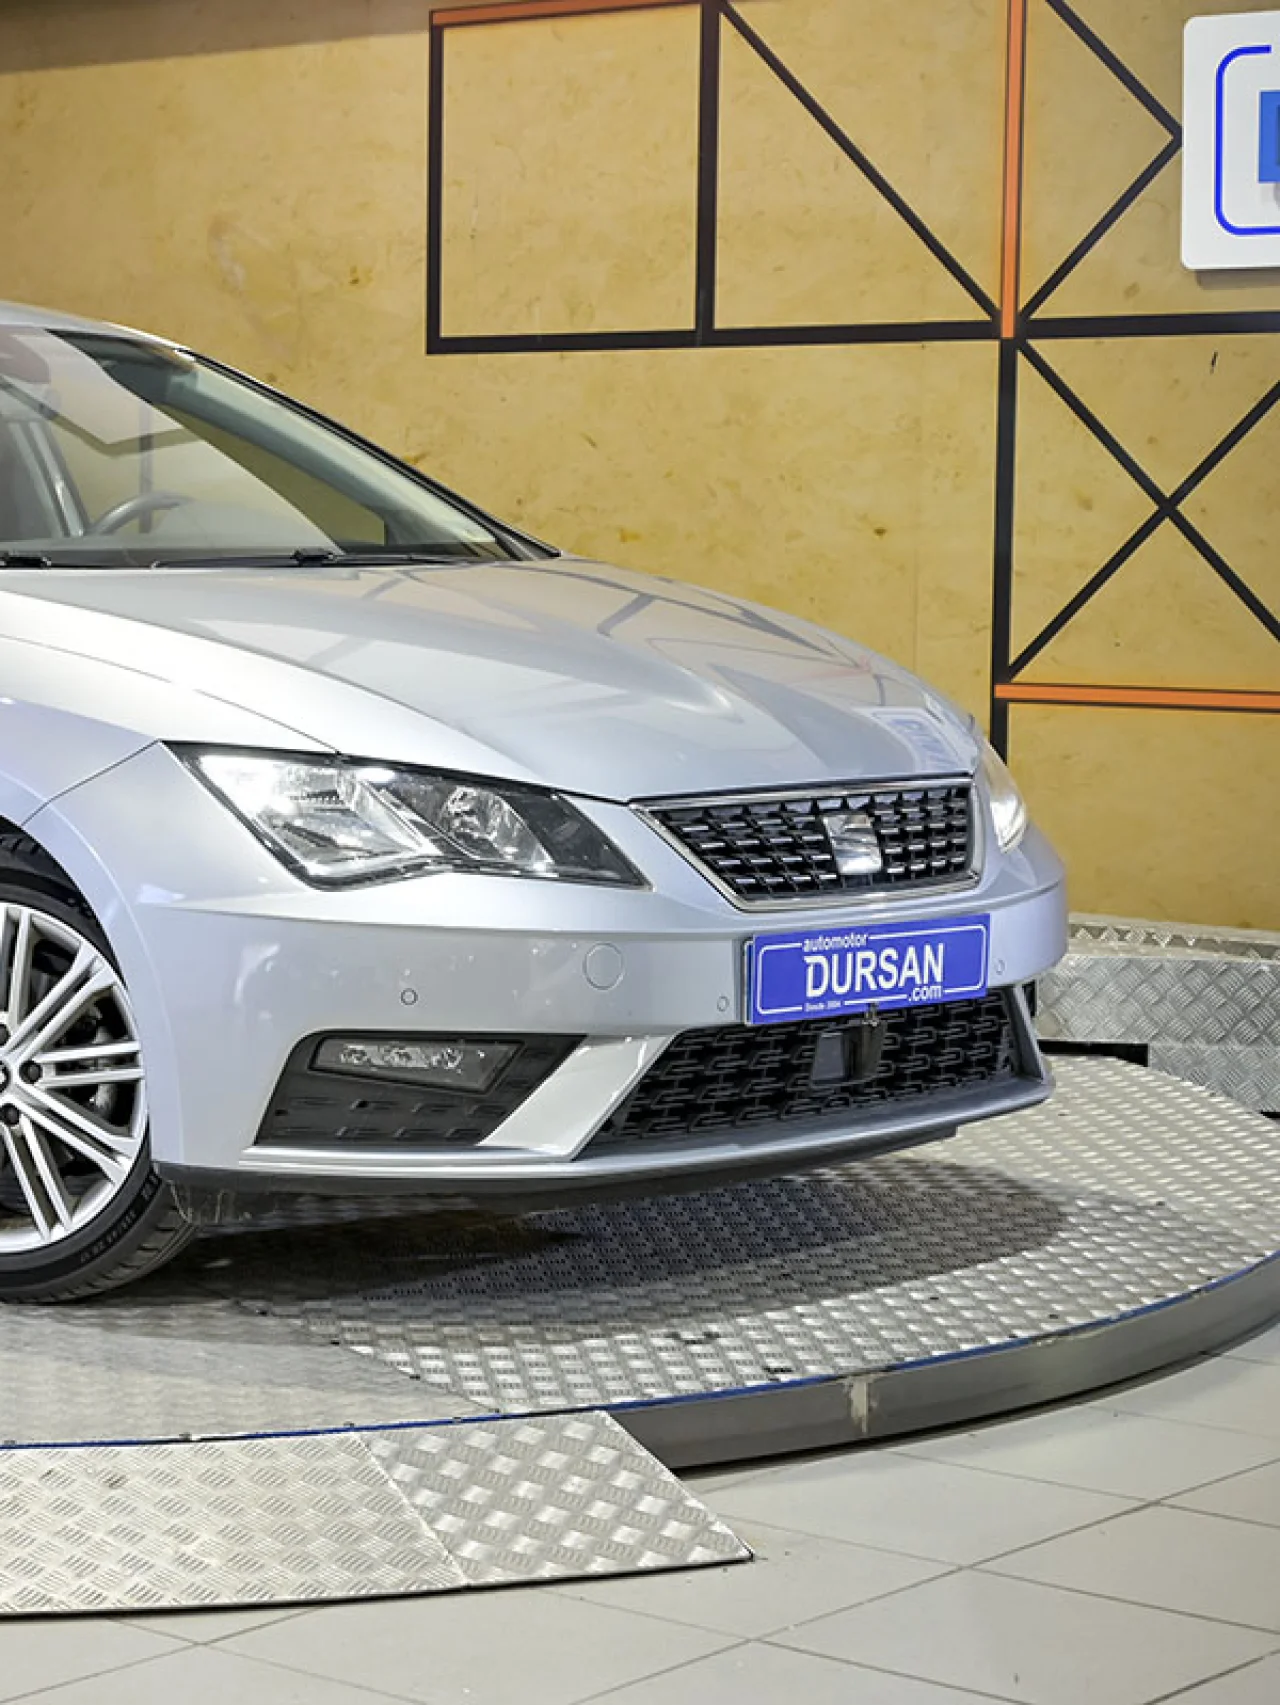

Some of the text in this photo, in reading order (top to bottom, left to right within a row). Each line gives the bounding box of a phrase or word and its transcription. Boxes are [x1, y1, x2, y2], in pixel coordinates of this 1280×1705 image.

[803, 932, 867, 952] automotor
[804, 943, 944, 997] DURSAN
[908, 985, 942, 1002] .com
